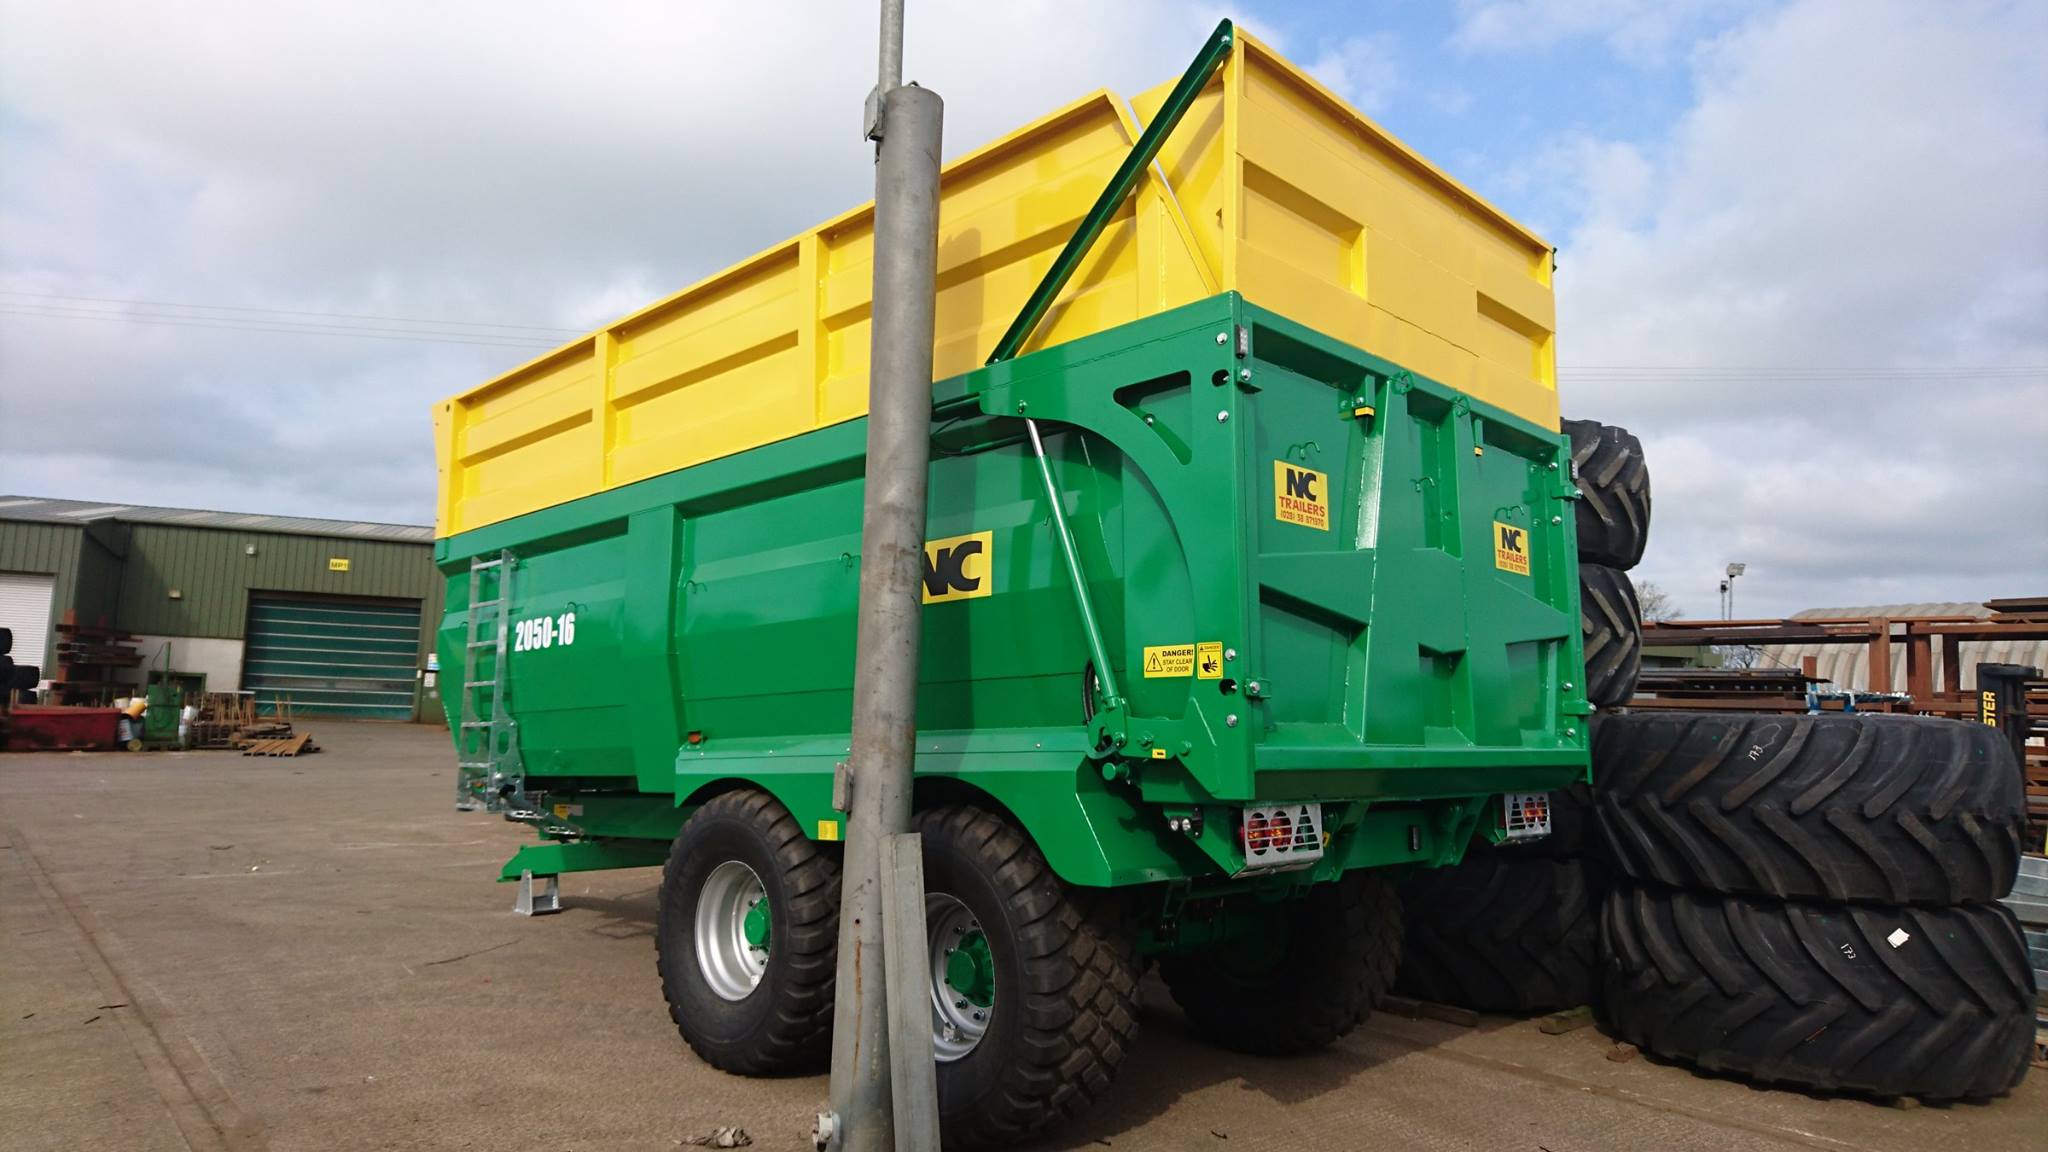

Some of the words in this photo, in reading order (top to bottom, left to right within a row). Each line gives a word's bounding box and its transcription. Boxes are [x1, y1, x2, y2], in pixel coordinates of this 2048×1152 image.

[1286, 468, 1317, 502] NC
[1279, 496, 1325, 517] TRAILERS
[1501, 527, 1521, 553] NC
[924, 540, 983, 597] NC
[1497, 549, 1527, 565] TRAILERS
[514, 612, 576, 652] 2050-16
[1840, 943, 1856, 960] 173
